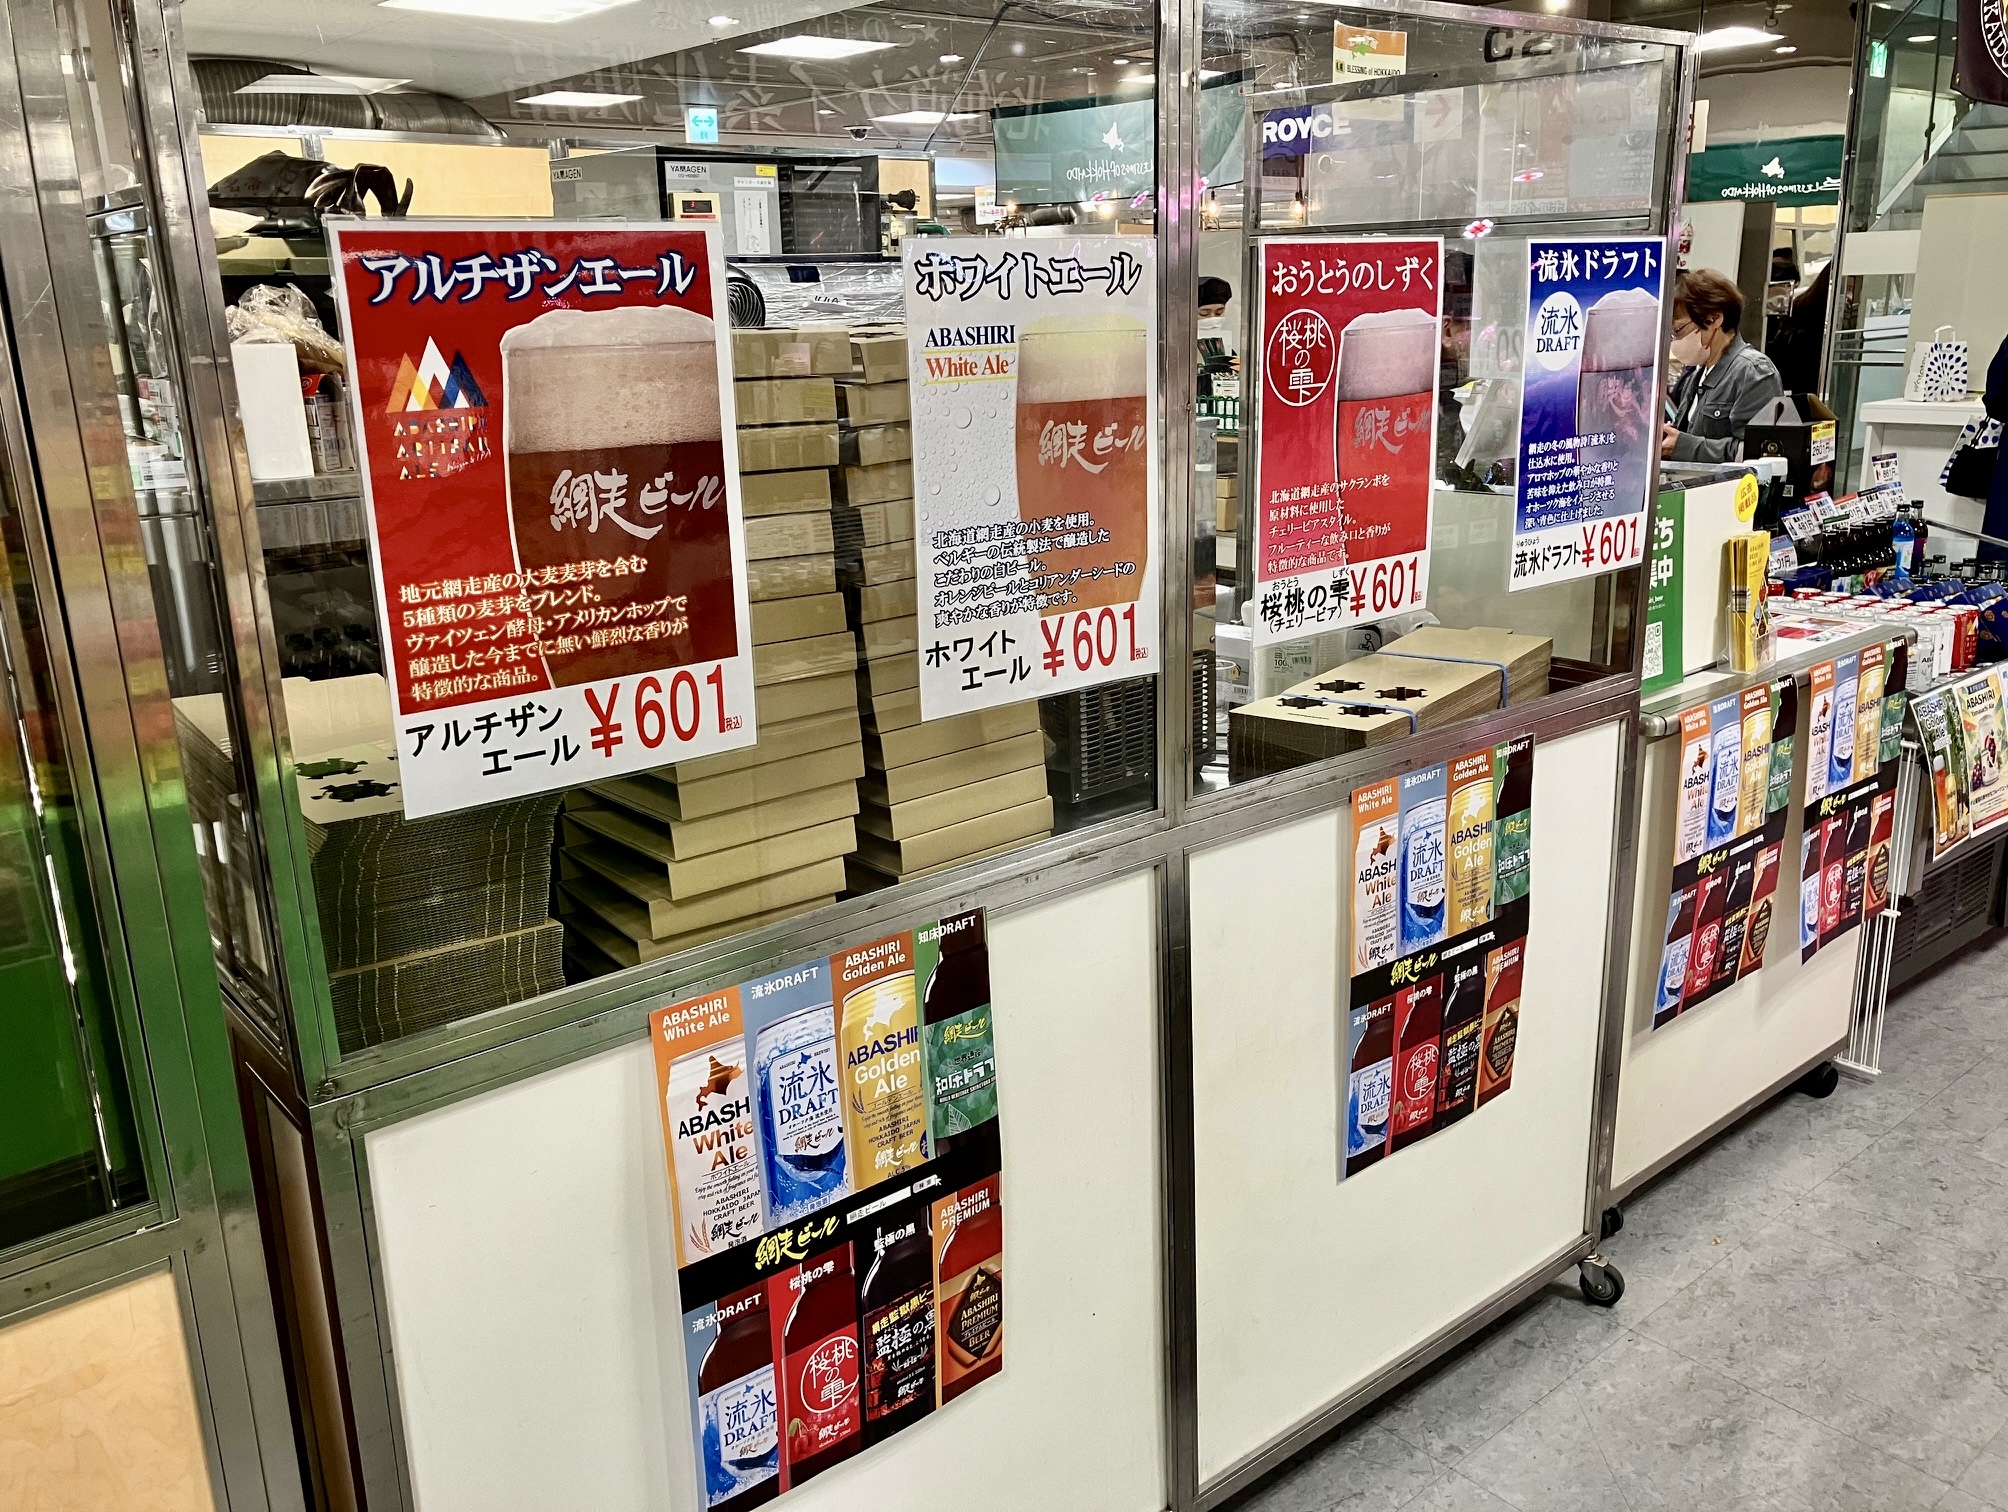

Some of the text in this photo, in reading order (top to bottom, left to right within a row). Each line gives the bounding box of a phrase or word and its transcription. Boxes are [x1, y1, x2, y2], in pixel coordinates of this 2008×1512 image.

[1347, 64, 1367, 75] BLESSING
[670, 165, 707, 175] YAMAGEN
[362, 251, 694, 306] アルチザンエール
[914, 251, 1142, 302] ホワイトエール
[1272, 256, 1433, 296] おうとうのしずく
[1538, 248, 1657, 282] 流氷ドラフト
[1541, 306, 1578, 335] 流氷
[925, 325, 1015, 348] ABASHIRI
[1536, 336, 1580, 353] DRAFT
[926, 355, 1009, 379] White Ale
[1038, 420, 1146, 474] 網走ビール
[400, 462, 439, 480] ALE
[1528, 453, 1575, 470] 仕込水に使用。
[1270, 473, 1390, 505] 北海道網走産のサクランボを
[549, 468, 726, 539] 網走ビール
[1269, 498, 1345, 522] 原材料に使用した
[933, 512, 1095, 550] 北海道網走産の小麦を使用。
[1268, 523, 1391, 556] フルーティーな飲み口と香りが
[1269, 514, 1357, 539] チェリービアスタイル。
[933, 529, 1110, 567] ベルギーの伝統製法で醸造した
[1267, 547, 1349, 575] 特徴的な商品です。
[1514, 517, 1637, 578] 流氷ドラフト ¥601
[399, 555, 647, 604] 地元網走産の大麦麦芽を含む
[934, 559, 1047, 587] こだわりの白ビール。
[1272, 566, 1350, 591] おうとう しずく
[1261, 556, 1418, 622] 桜桃の雫 ¥601
[404, 584, 601, 628] 5種類の麦芽をブレンド。
[934, 589, 1078, 628] 爽やかな香りが特徴です。
[1269, 606, 1343, 633] (チェリービア)
[409, 618, 688, 677] 醸造した今までに無い鮮烈な香りが
[926, 630, 1015, 668] ホワイト
[1041, 603, 1135, 677] ¥601
[412, 669, 539, 702] 特徴的な商品。
[962, 656, 1031, 691] エール
[584, 664, 726, 758] ¥601
[1918, 697, 1947, 719] ABASHIRI
[1967, 689, 1995, 709] ABASHIRI
[406, 702, 563, 757] アルチザン
[482, 734, 580, 776] エール
[1455, 753, 1486, 772] ABASHIRI
[1453, 764, 1489, 782] Golden Ale
[1717, 775, 1739, 791] DRAFT
[1357, 784, 1392, 803] ABASHIRI
[1358, 796, 1393, 813] White Ale
[1413, 837, 1443, 868] 流氷
[1454, 837, 1492, 859] Golden
[1464, 853, 1484, 871] Ale
[1410, 860, 1444, 882] DRAFT
[1365, 878, 1396, 897] White
[1372, 894, 1391, 910] Ale
[918, 915, 976, 944] 知床DRAFT
[843, 953, 905, 981] Golden Ale
[845, 940, 900, 968] ABASHIRI
[1492, 946, 1520, 965] ABASHIRI
[751, 967, 818, 999] 流氷DRAFT
[1391, 952, 1438, 986] 網走ビール
[663, 997, 728, 1028] ABASHIRI
[1353, 1003, 1392, 1027] 流氷DRAFT
[664, 1012, 730, 1042] White Ale
[855, 1049, 920, 1085] Golden
[779, 1061, 834, 1105] 流氷
[874, 1074, 908, 1099] Ale
[1362, 1077, 1391, 1100] 流氷
[779, 1088, 838, 1125] DRAFT
[1361, 1093, 1391, 1113] DRAFT
[693, 1121, 753, 1154] White
[868, 1119, 920, 1144] HOKKAIDO JAPAN
[879, 1116, 909, 1132] ABASHIRI
[795, 1128, 833, 1153] 網走ビール
[877, 1129, 914, 1148] CRAFT BEER
[711, 1144, 748, 1171] Ale
[703, 1201, 739, 1216] HOKKAIDO
[716, 1187, 749, 1205] ABASHIRI
[941, 1188, 988, 1218] ABASHIRI
[714, 1201, 755, 1221] CRAFT BEER
[942, 1198, 990, 1230] PREMIUM
[711, 1213, 760, 1241] 網走ビール
[874, 1223, 915, 1252] 監極の黒
[755, 1215, 840, 1270] 網走ビール
[789, 1261, 834, 1291] 桜桃の雫
[692, 1293, 761, 1333] 流氷DRAFT
[961, 1293, 998, 1321] ABASHIRI
[961, 1304, 998, 1331] PREMIUM
[969, 1329, 990, 1348] BEER
[725, 1389, 776, 1430] 流氷
[724, 1410, 777, 1447] DRAFT
